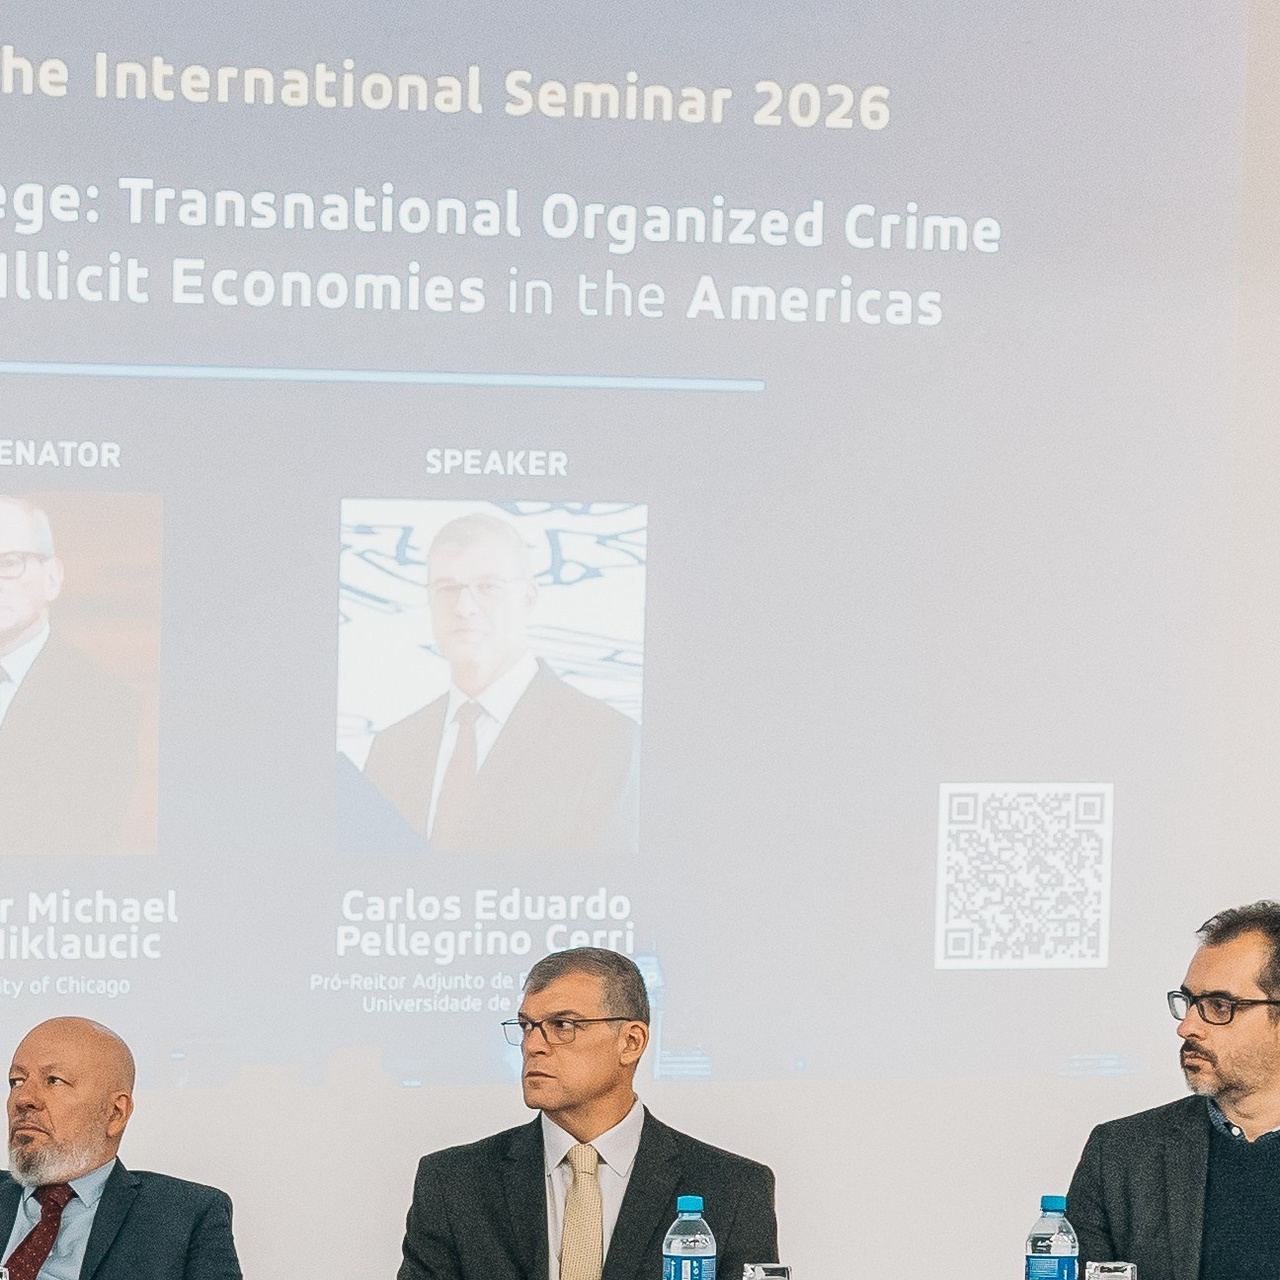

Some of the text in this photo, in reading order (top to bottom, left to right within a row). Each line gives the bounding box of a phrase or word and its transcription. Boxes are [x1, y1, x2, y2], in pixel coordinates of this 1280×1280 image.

[96, 53, 482, 113] International
[505, 71, 732, 123] Seminar
[754, 81, 889, 130] 2026
[119, 178, 520, 236] Transnational
[543, 194, 823, 254] Organized
[845, 202, 1000, 252] Crime
[173, 259, 485, 313] Economies
[510, 267, 552, 314] in
[579, 270, 664, 317] the
[687, 275, 942, 325] Americas
[426, 449, 567, 475] SPEAKER
[29, 889, 178, 923] Michael
[342, 887, 630, 921] Carlos Eduardo
[337, 922, 531, 964] Pellegrino
[29, 975, 51, 995] of
[55, 976, 131, 999] Chicago
[310, 973, 407, 991] Pró-Reitor
[412, 972, 486, 995] Adjunto
[490, 971, 514, 990] de
[362, 994, 483, 1013] Universidade
[487, 994, 511, 1012] de
